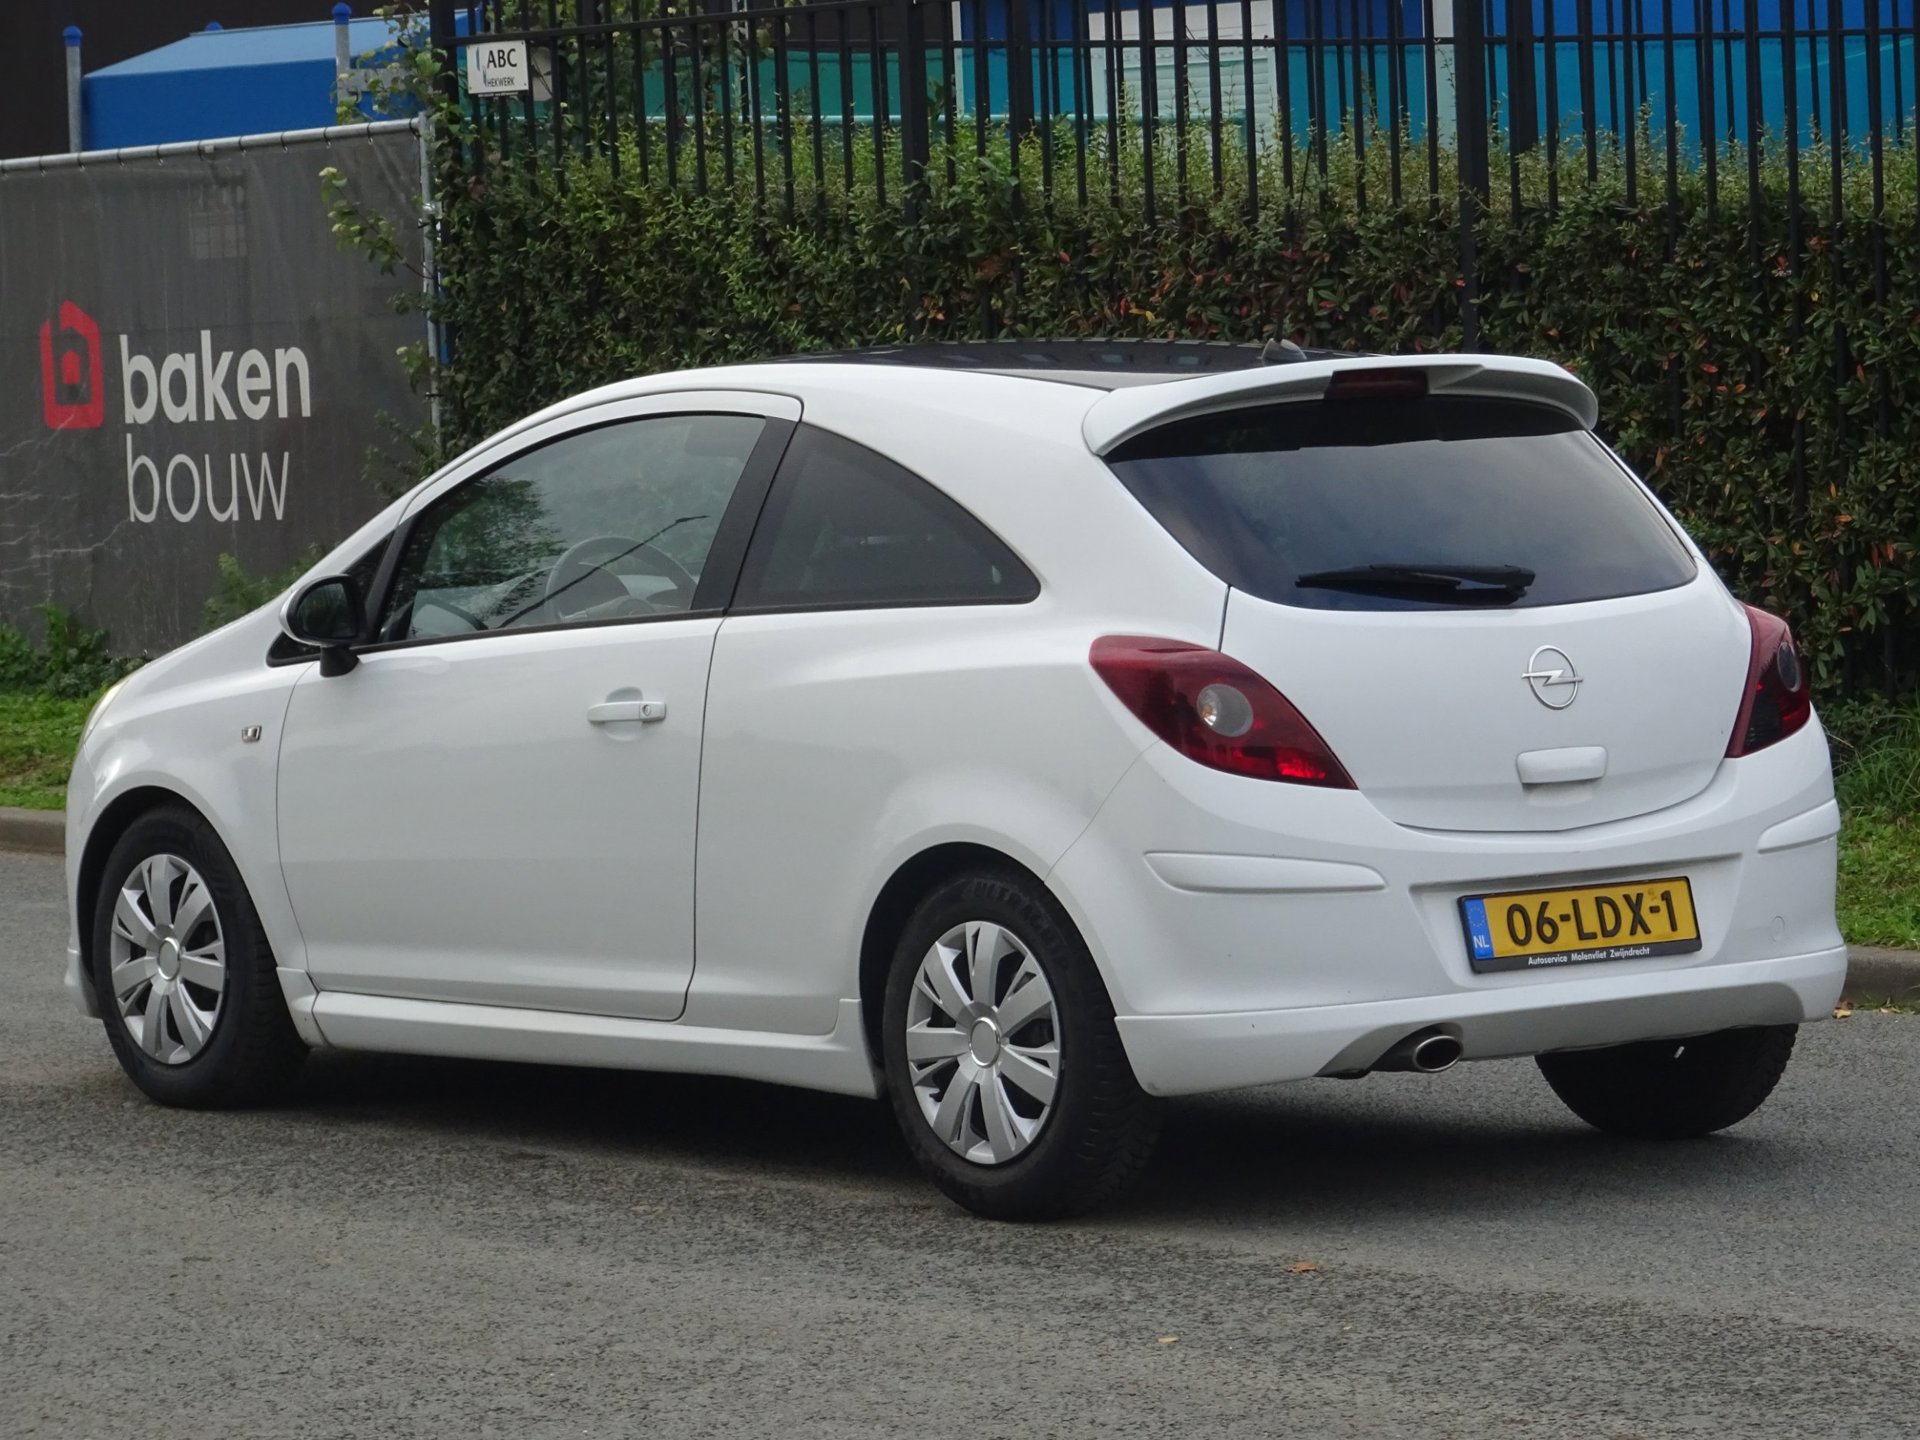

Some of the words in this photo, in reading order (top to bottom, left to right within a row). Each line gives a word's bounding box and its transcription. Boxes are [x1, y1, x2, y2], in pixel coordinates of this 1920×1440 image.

[487, 48, 517, 69] ABC
[487, 77, 515, 87] HEKWERK
[119, 329, 312, 425] baken
[126, 433, 290, 523] bouw
[1506, 890, 1678, 946] 06-LDX-1
[1473, 934, 1490, 949] NL
[1528, 954, 1568, 966] Autoservice
[1571, 950, 1607, 962] Molenvliet
[1610, 947, 1650, 959] Zwijndrecht
